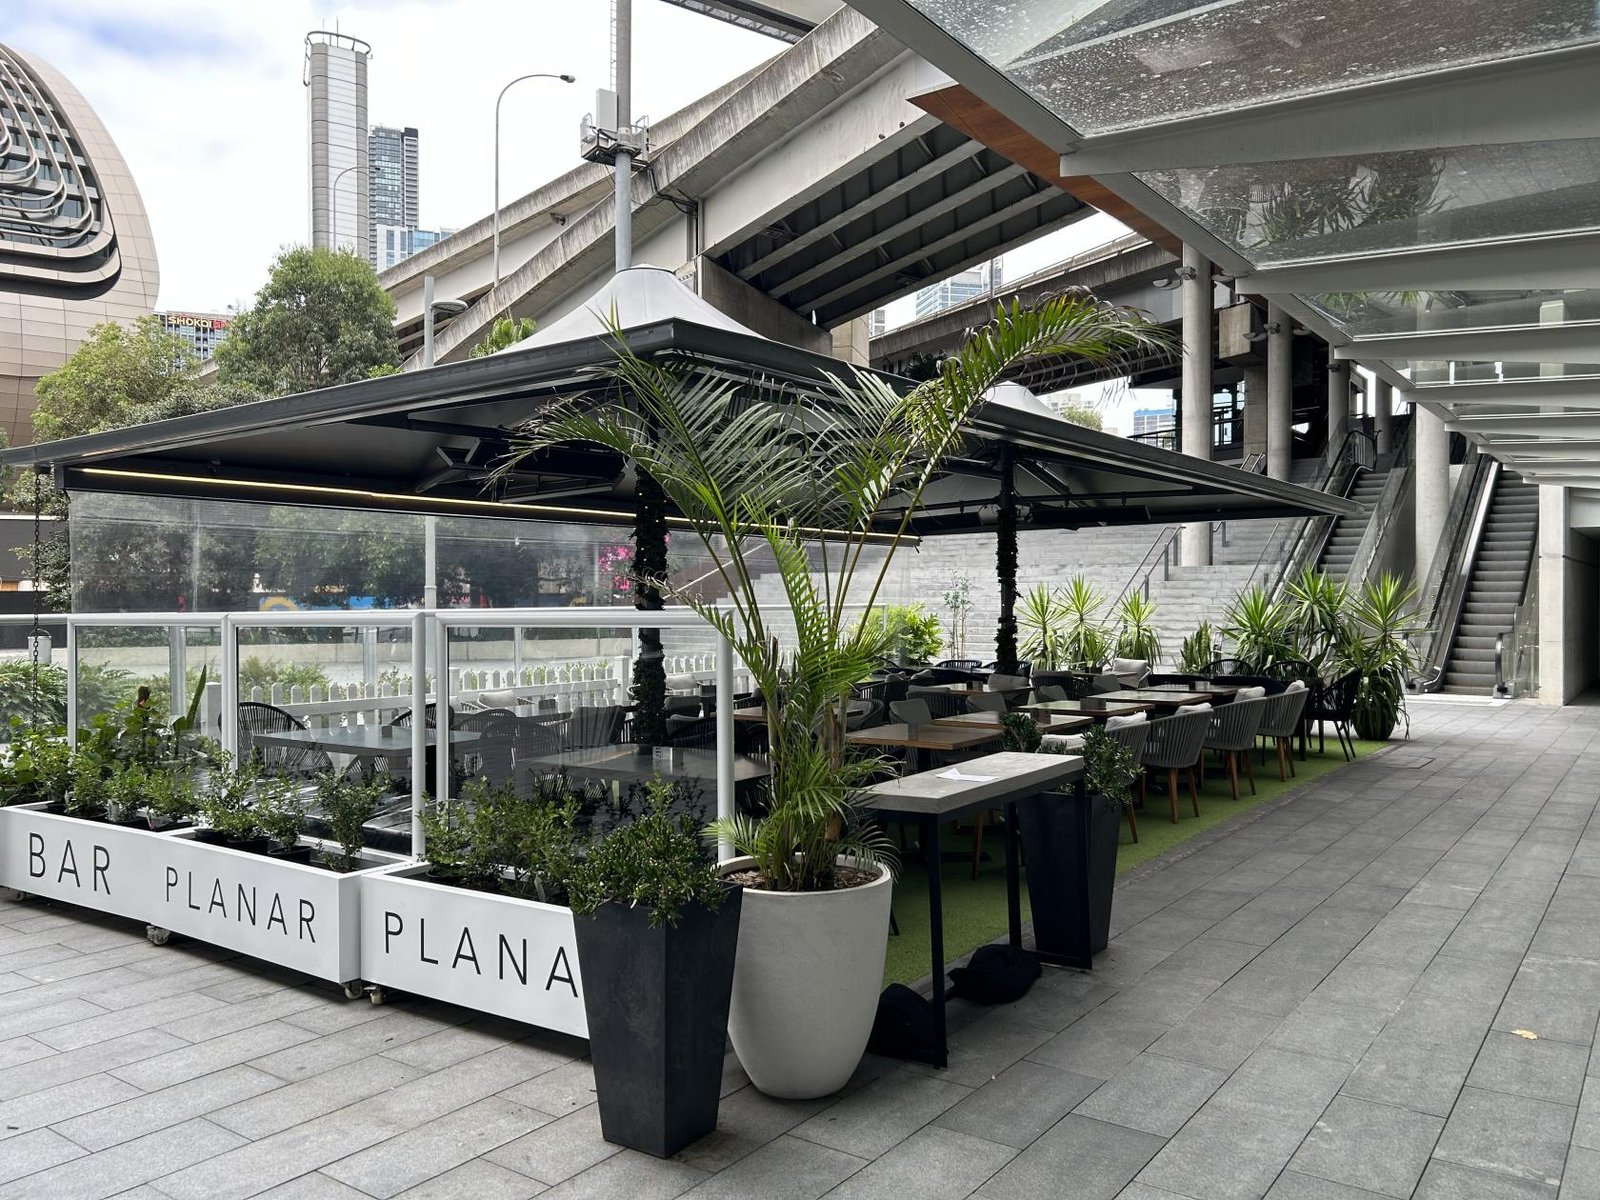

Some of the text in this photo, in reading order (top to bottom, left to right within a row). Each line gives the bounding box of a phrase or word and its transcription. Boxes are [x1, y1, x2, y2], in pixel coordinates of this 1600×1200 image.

[29, 832, 316, 943] BAR PLANAR
[384, 911, 579, 998] PLANA
